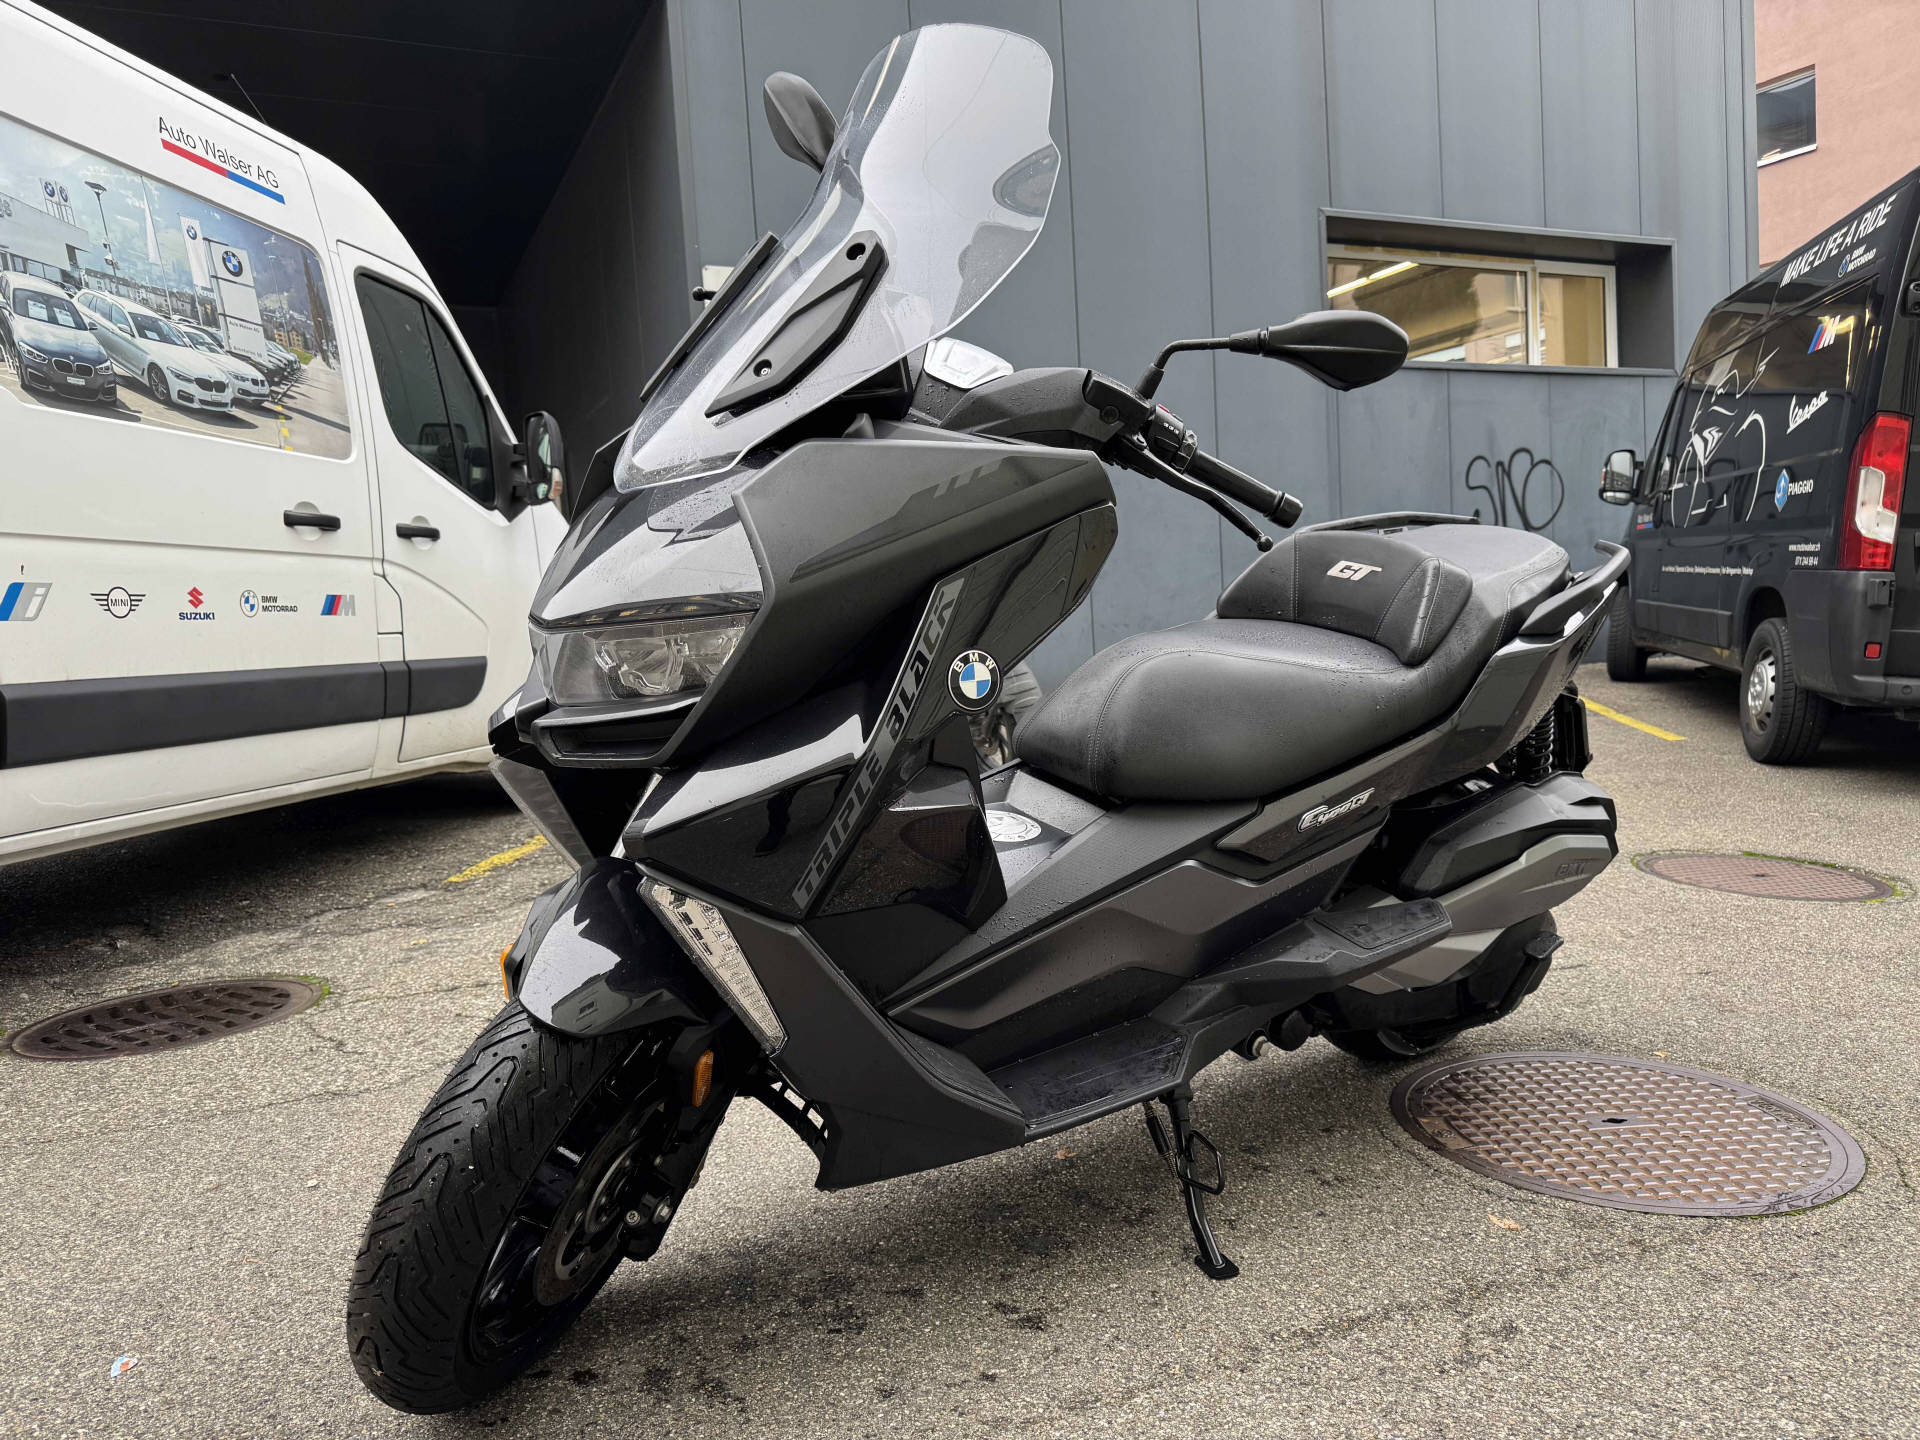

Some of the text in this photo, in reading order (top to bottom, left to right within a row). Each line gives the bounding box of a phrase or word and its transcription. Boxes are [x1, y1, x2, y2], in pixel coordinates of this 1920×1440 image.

[159, 116, 279, 189] Auto Walser AG
[1780, 193, 1898, 288] MAKE LIFE A RIDE
[1787, 390, 1829, 434] Vespa
[1787, 479, 1814, 495] PIAGGIO
[1326, 560, 1383, 581] GT
[110, 598, 129, 607] MINI
[261, 595, 278, 604] BMW
[178, 612, 215, 621] SUZUKI
[261, 605, 298, 613] MOTORRAD
[798, 589, 956, 897] TRIPLE BLACK
